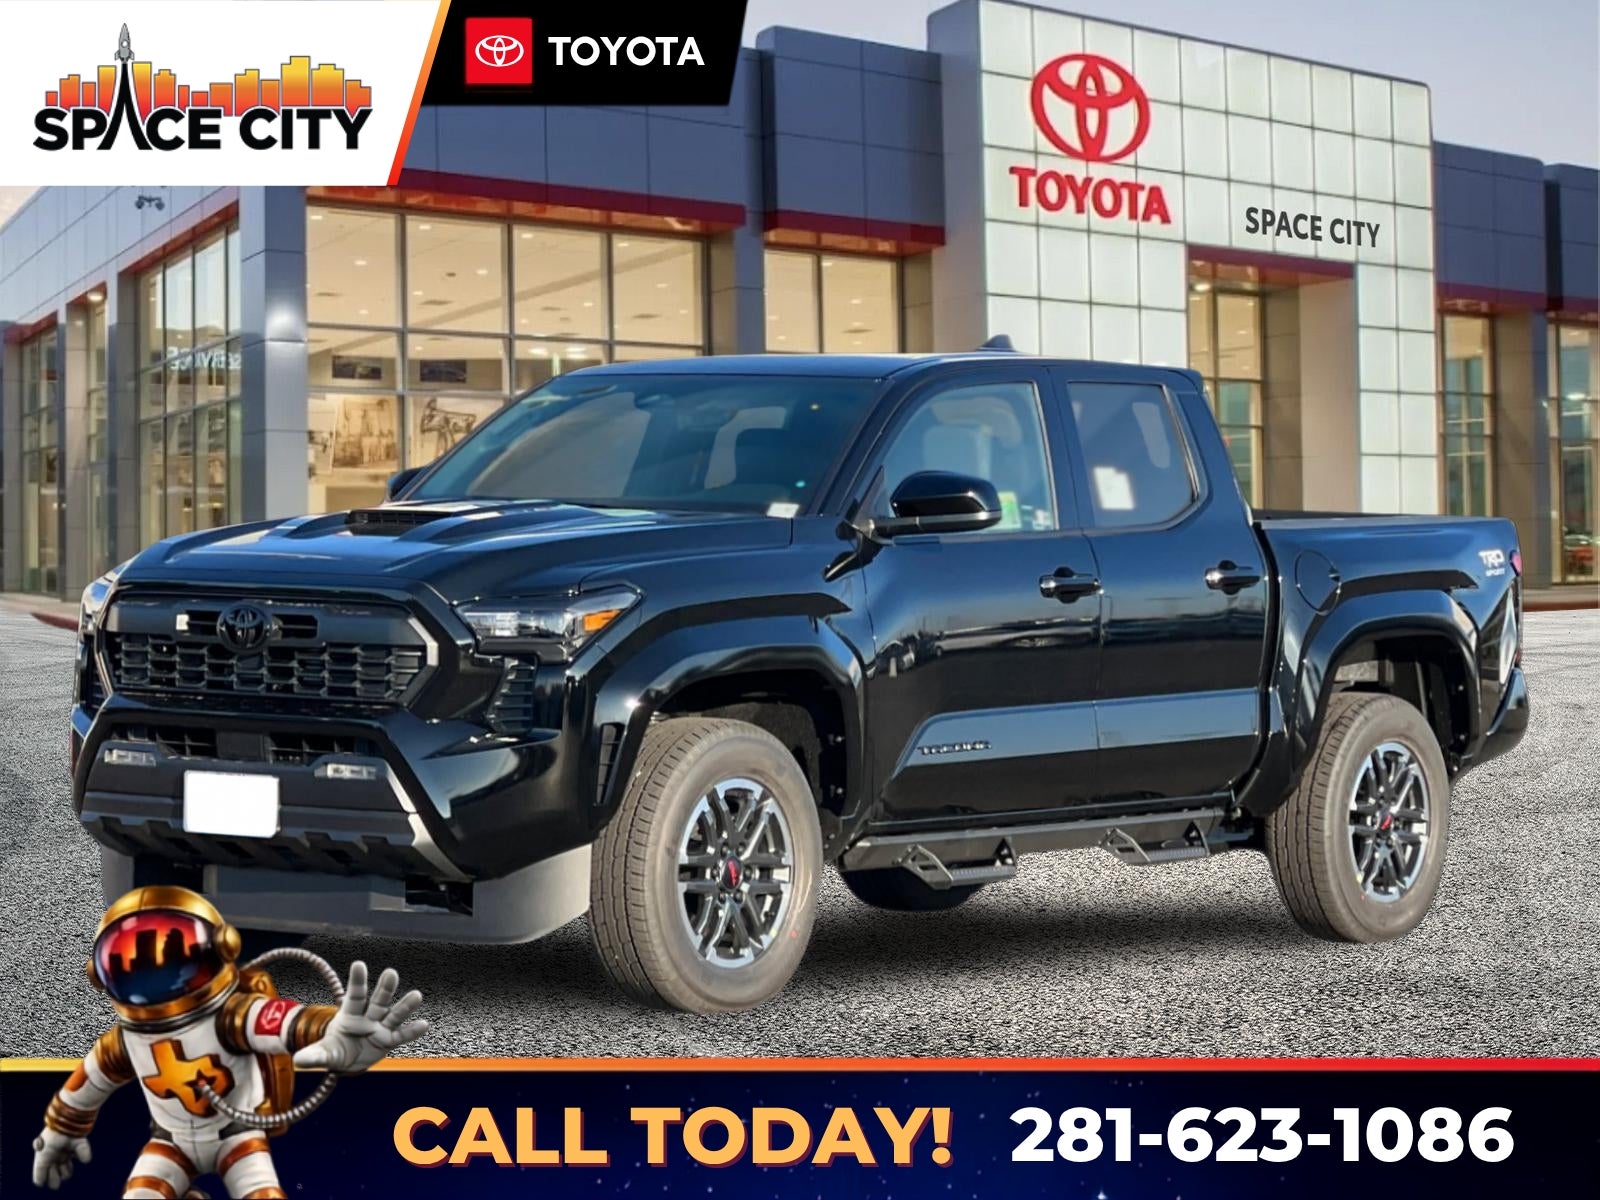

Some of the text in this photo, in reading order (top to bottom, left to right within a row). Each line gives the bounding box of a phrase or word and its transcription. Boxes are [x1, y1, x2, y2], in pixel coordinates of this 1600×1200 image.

[1009, 166, 1171, 224] TOYOTA
[1245, 206, 1380, 248] SPACE CITY
[1478, 550, 1505, 567] TRD
